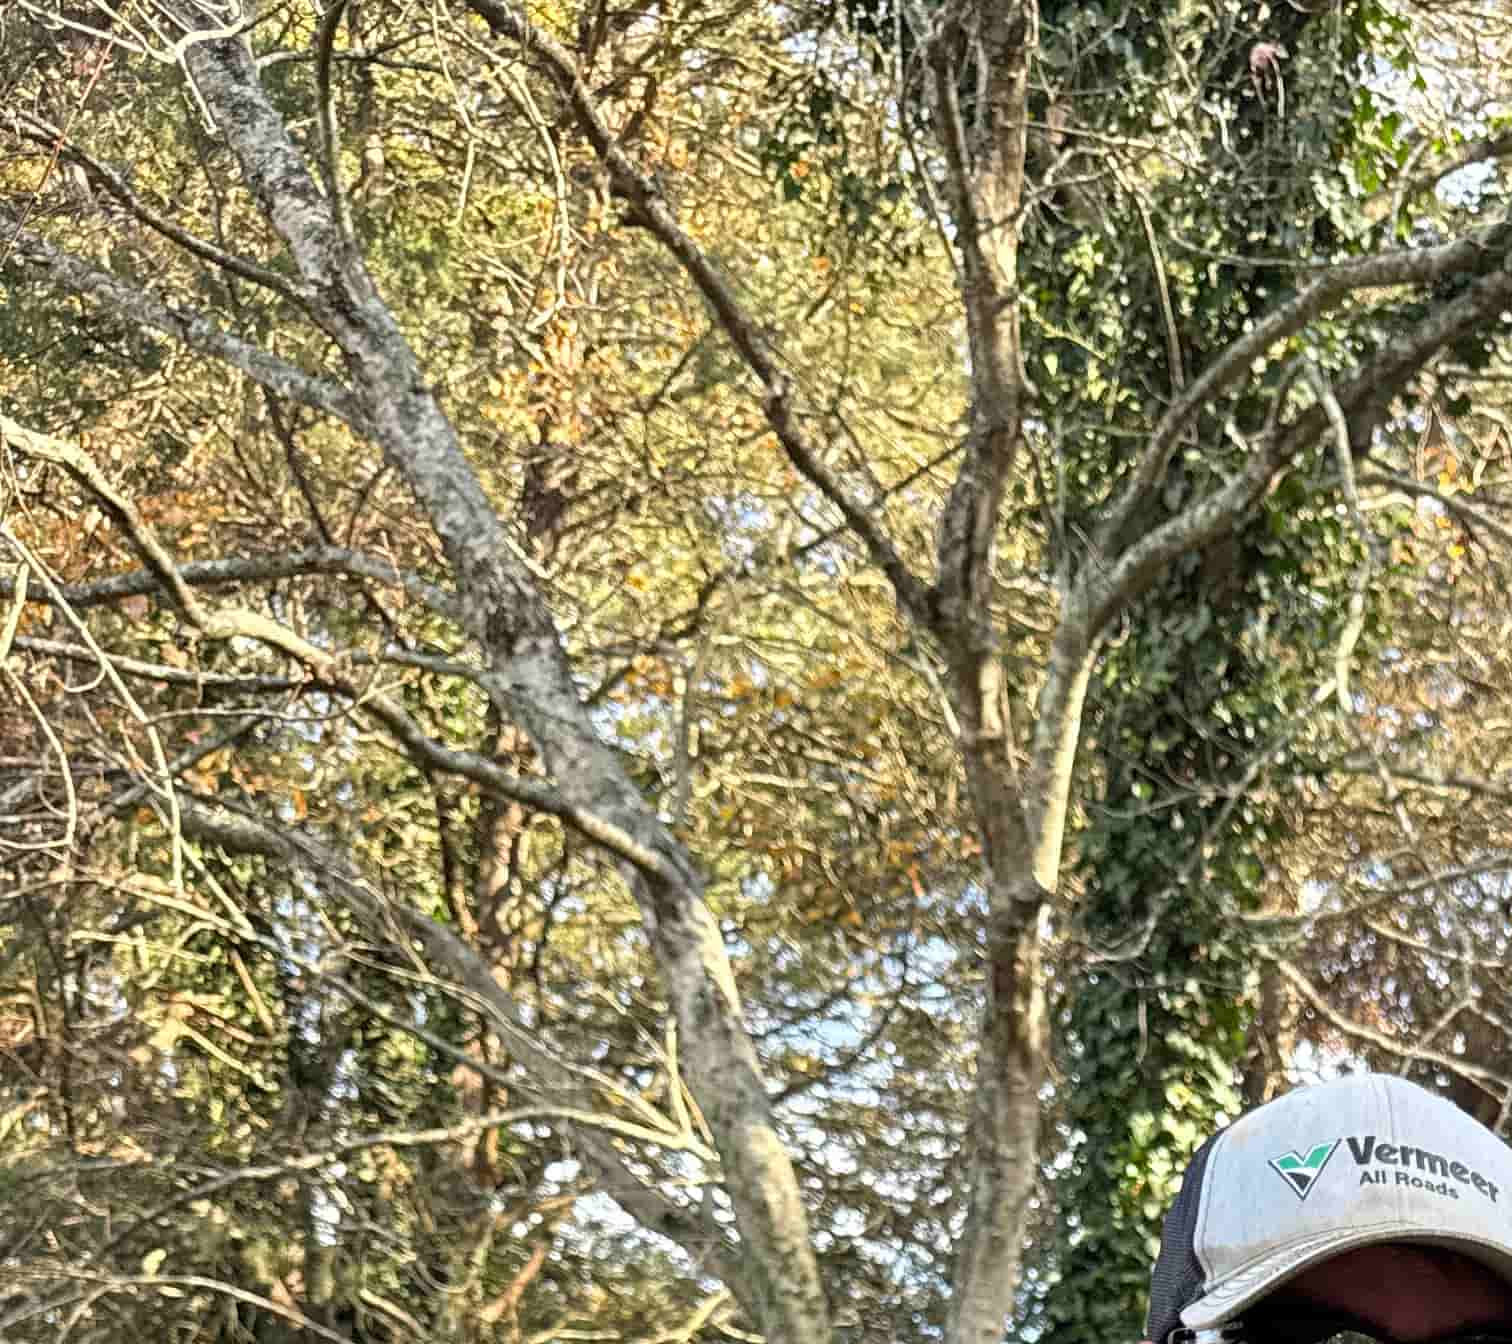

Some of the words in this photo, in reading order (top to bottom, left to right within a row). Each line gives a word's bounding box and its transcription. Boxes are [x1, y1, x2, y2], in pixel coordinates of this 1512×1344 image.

[1346, 1136, 1499, 1202] Vermeer
[1360, 1170, 1386, 1185] All
[1395, 1171, 1459, 1199] Roads
